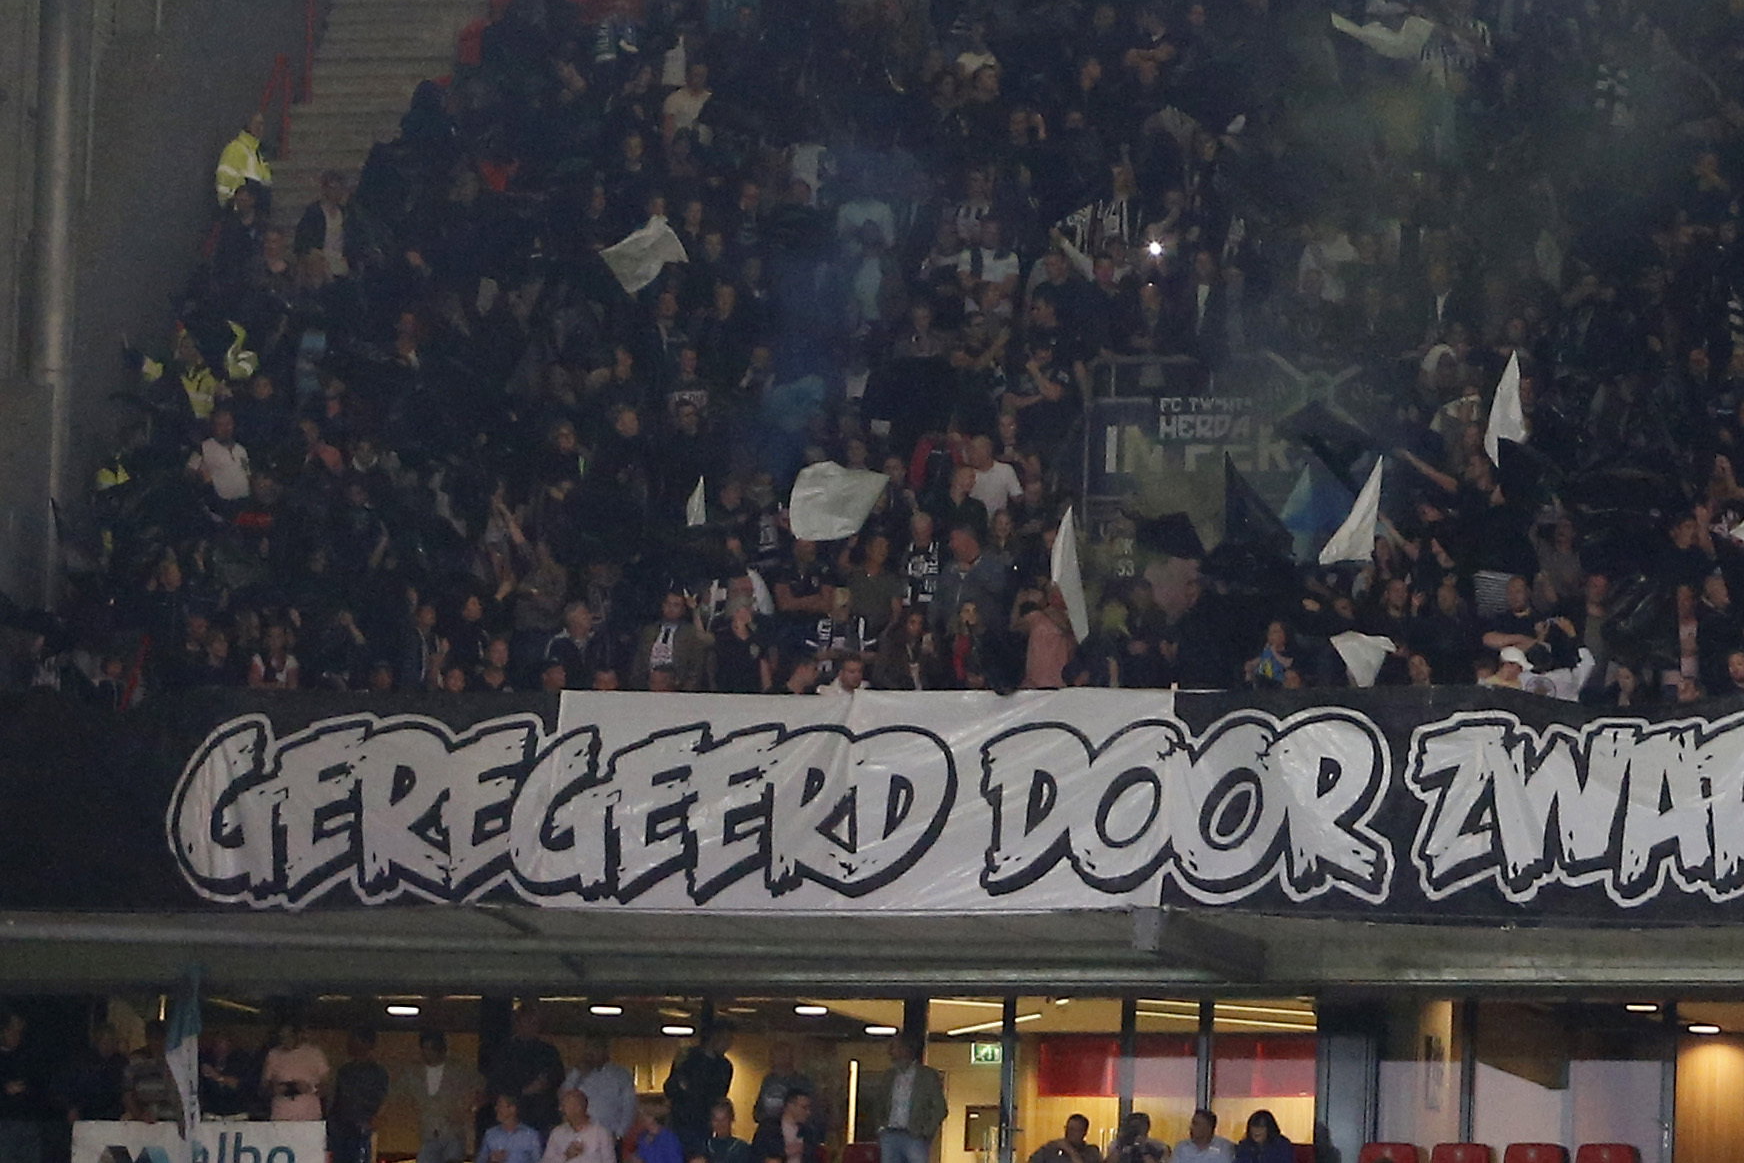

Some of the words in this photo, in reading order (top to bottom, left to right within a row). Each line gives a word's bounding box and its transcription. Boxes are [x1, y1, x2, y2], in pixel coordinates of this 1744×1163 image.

[1159, 397, 1182, 412] FC
[166, 712, 959, 909] GEREGEERD
[980, 706, 1393, 904] DOOR
